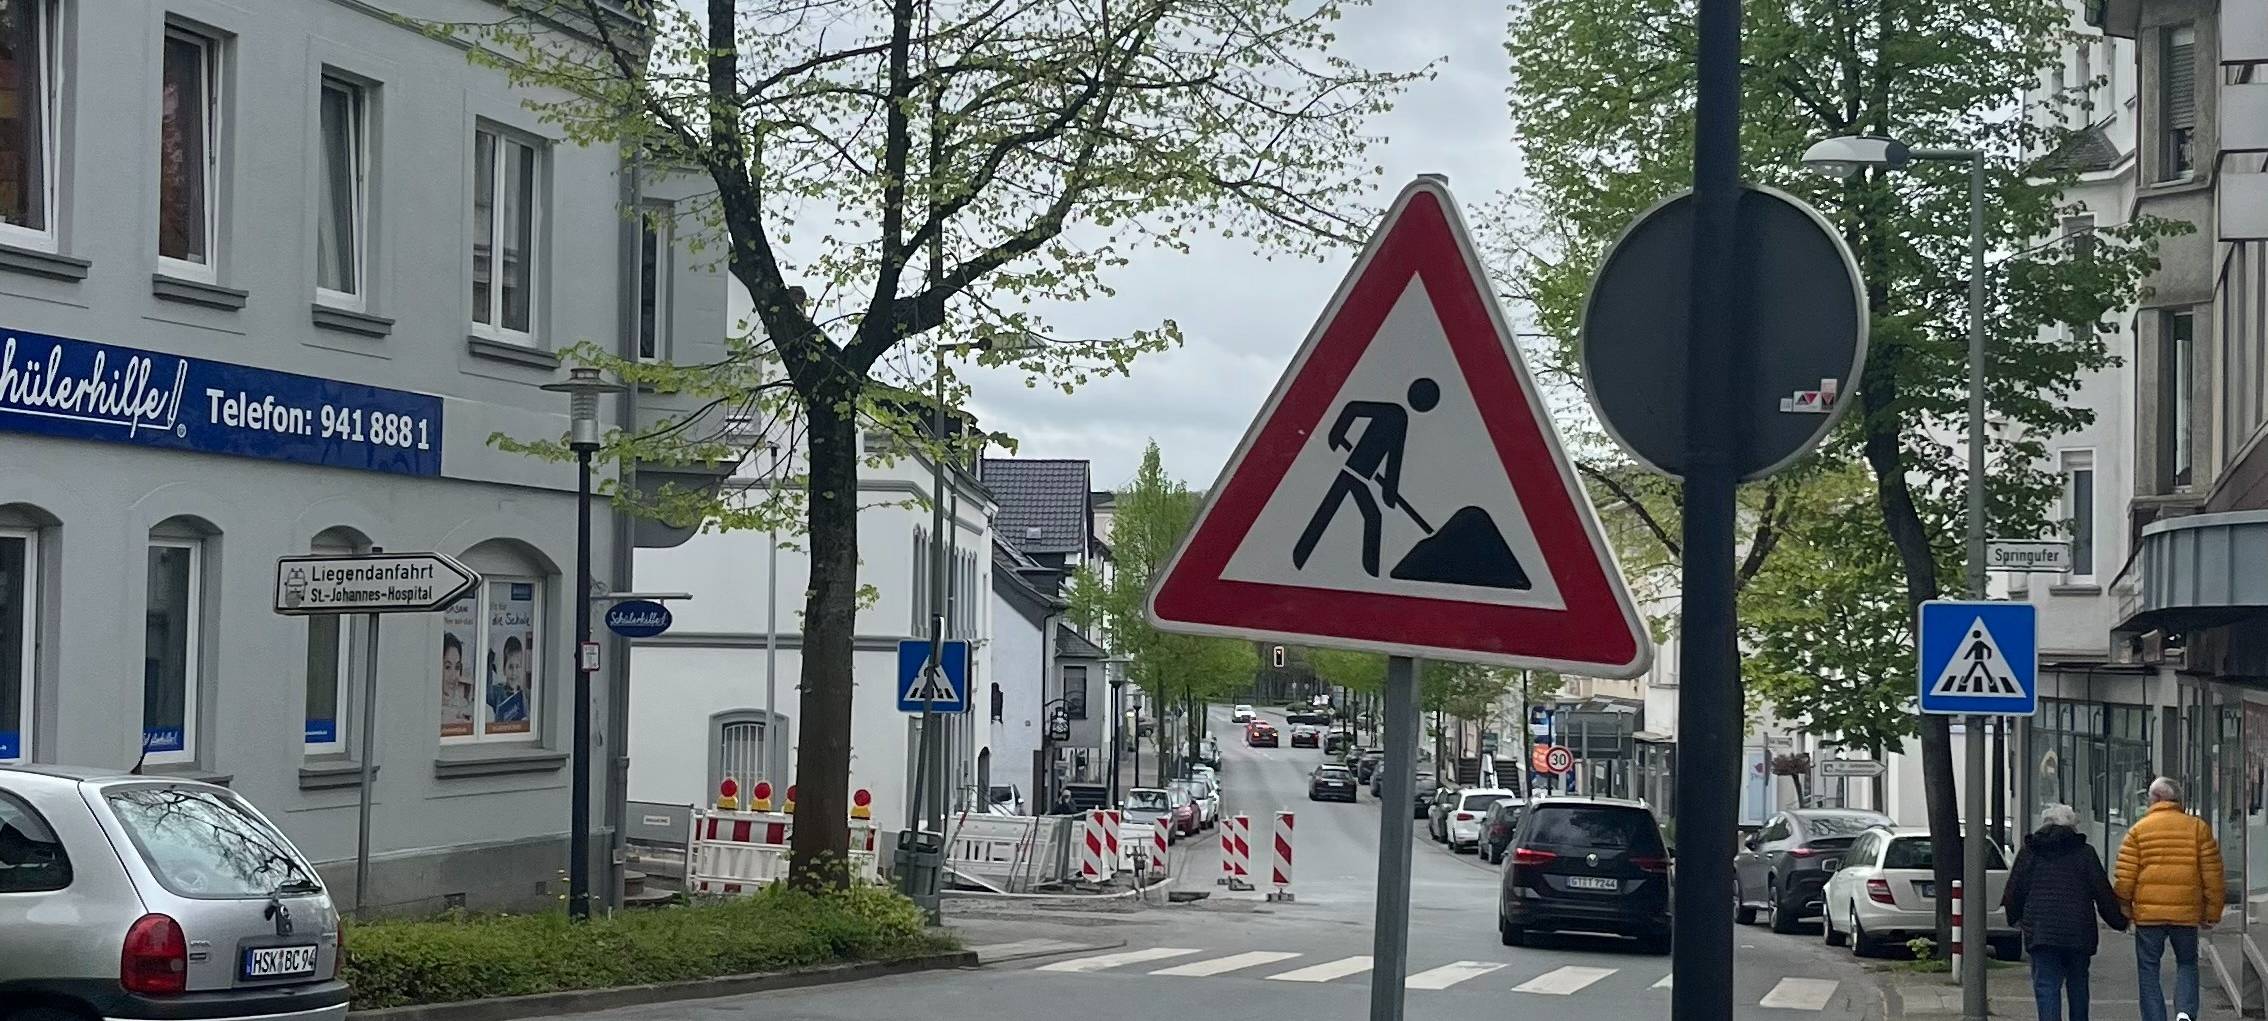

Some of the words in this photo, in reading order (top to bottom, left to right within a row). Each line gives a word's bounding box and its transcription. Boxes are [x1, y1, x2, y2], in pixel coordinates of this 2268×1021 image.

[206, 387, 312, 435] Telefon:
[320, 404, 365, 442] 941
[1994, 547, 2060, 566] Springufer
[311, 563, 434, 584] Liegendanfahrt
[310, 585, 433, 604] St.-Johannes-Hospital
[1551, 753, 1567, 766] 30
[253, 950, 278, 974] HSK
[284, 949, 300, 972] BC
